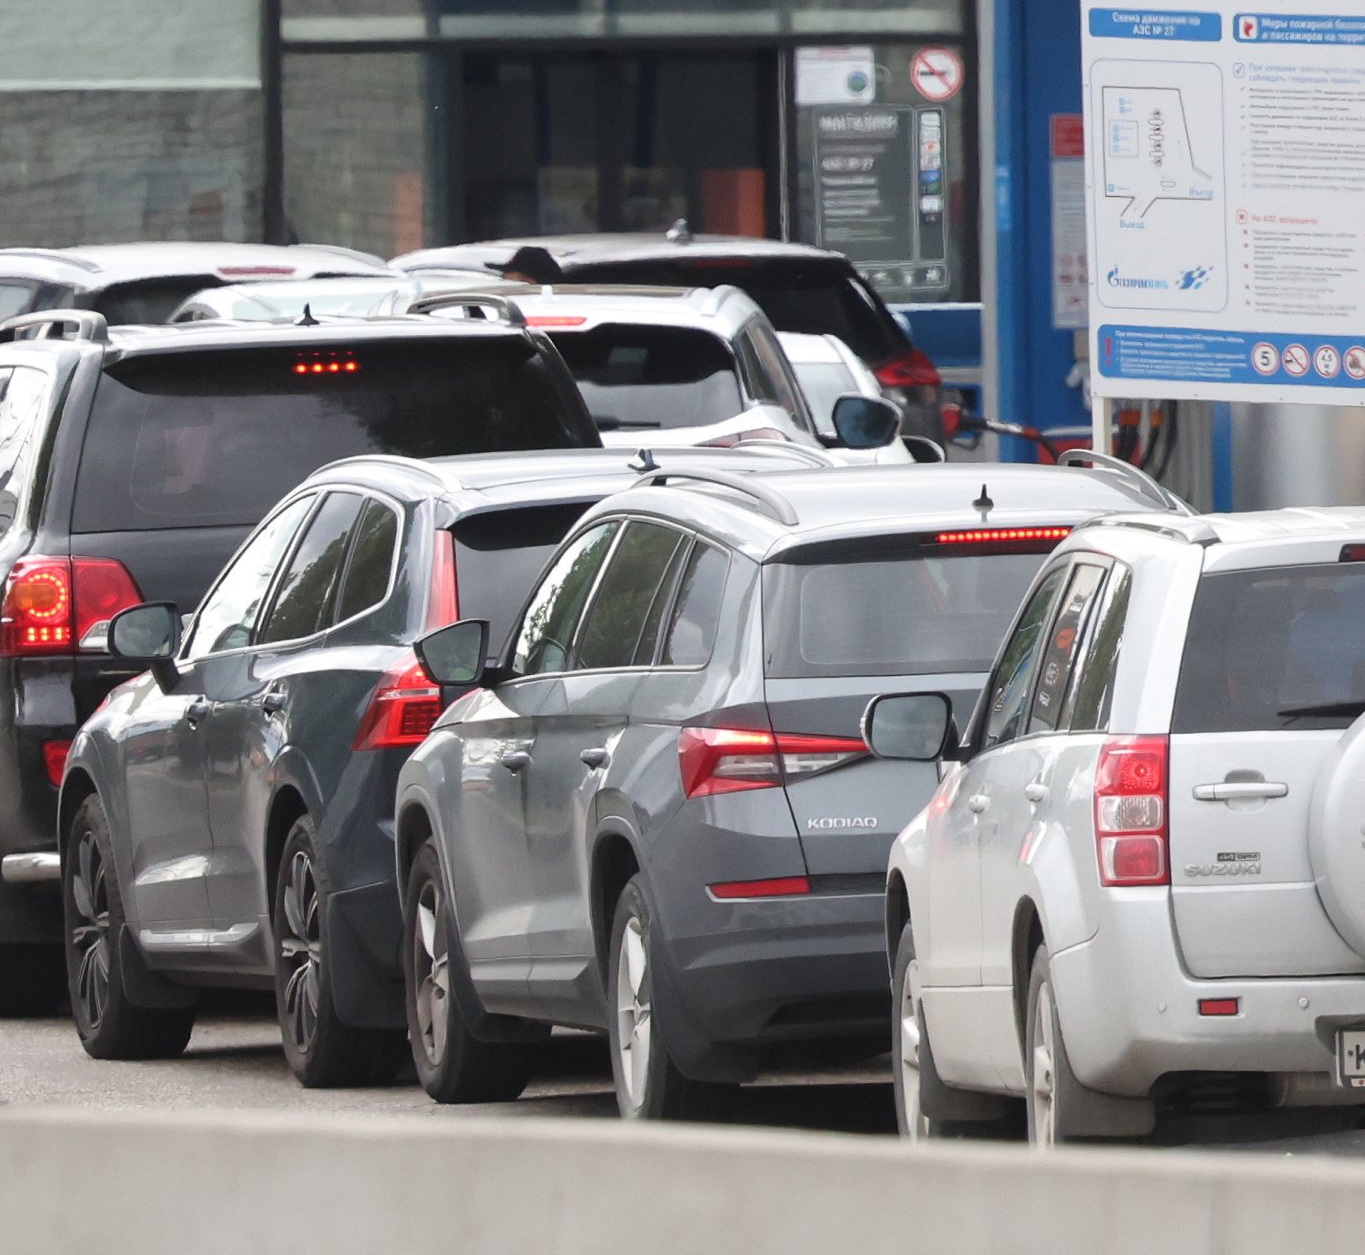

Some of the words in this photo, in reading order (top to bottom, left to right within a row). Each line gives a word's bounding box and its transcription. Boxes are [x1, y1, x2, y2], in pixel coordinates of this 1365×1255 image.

[1260, 350, 1271, 367] 5
[807, 817, 878, 829] KODIAQ
[1184, 863, 1262, 877] SUZUKI
